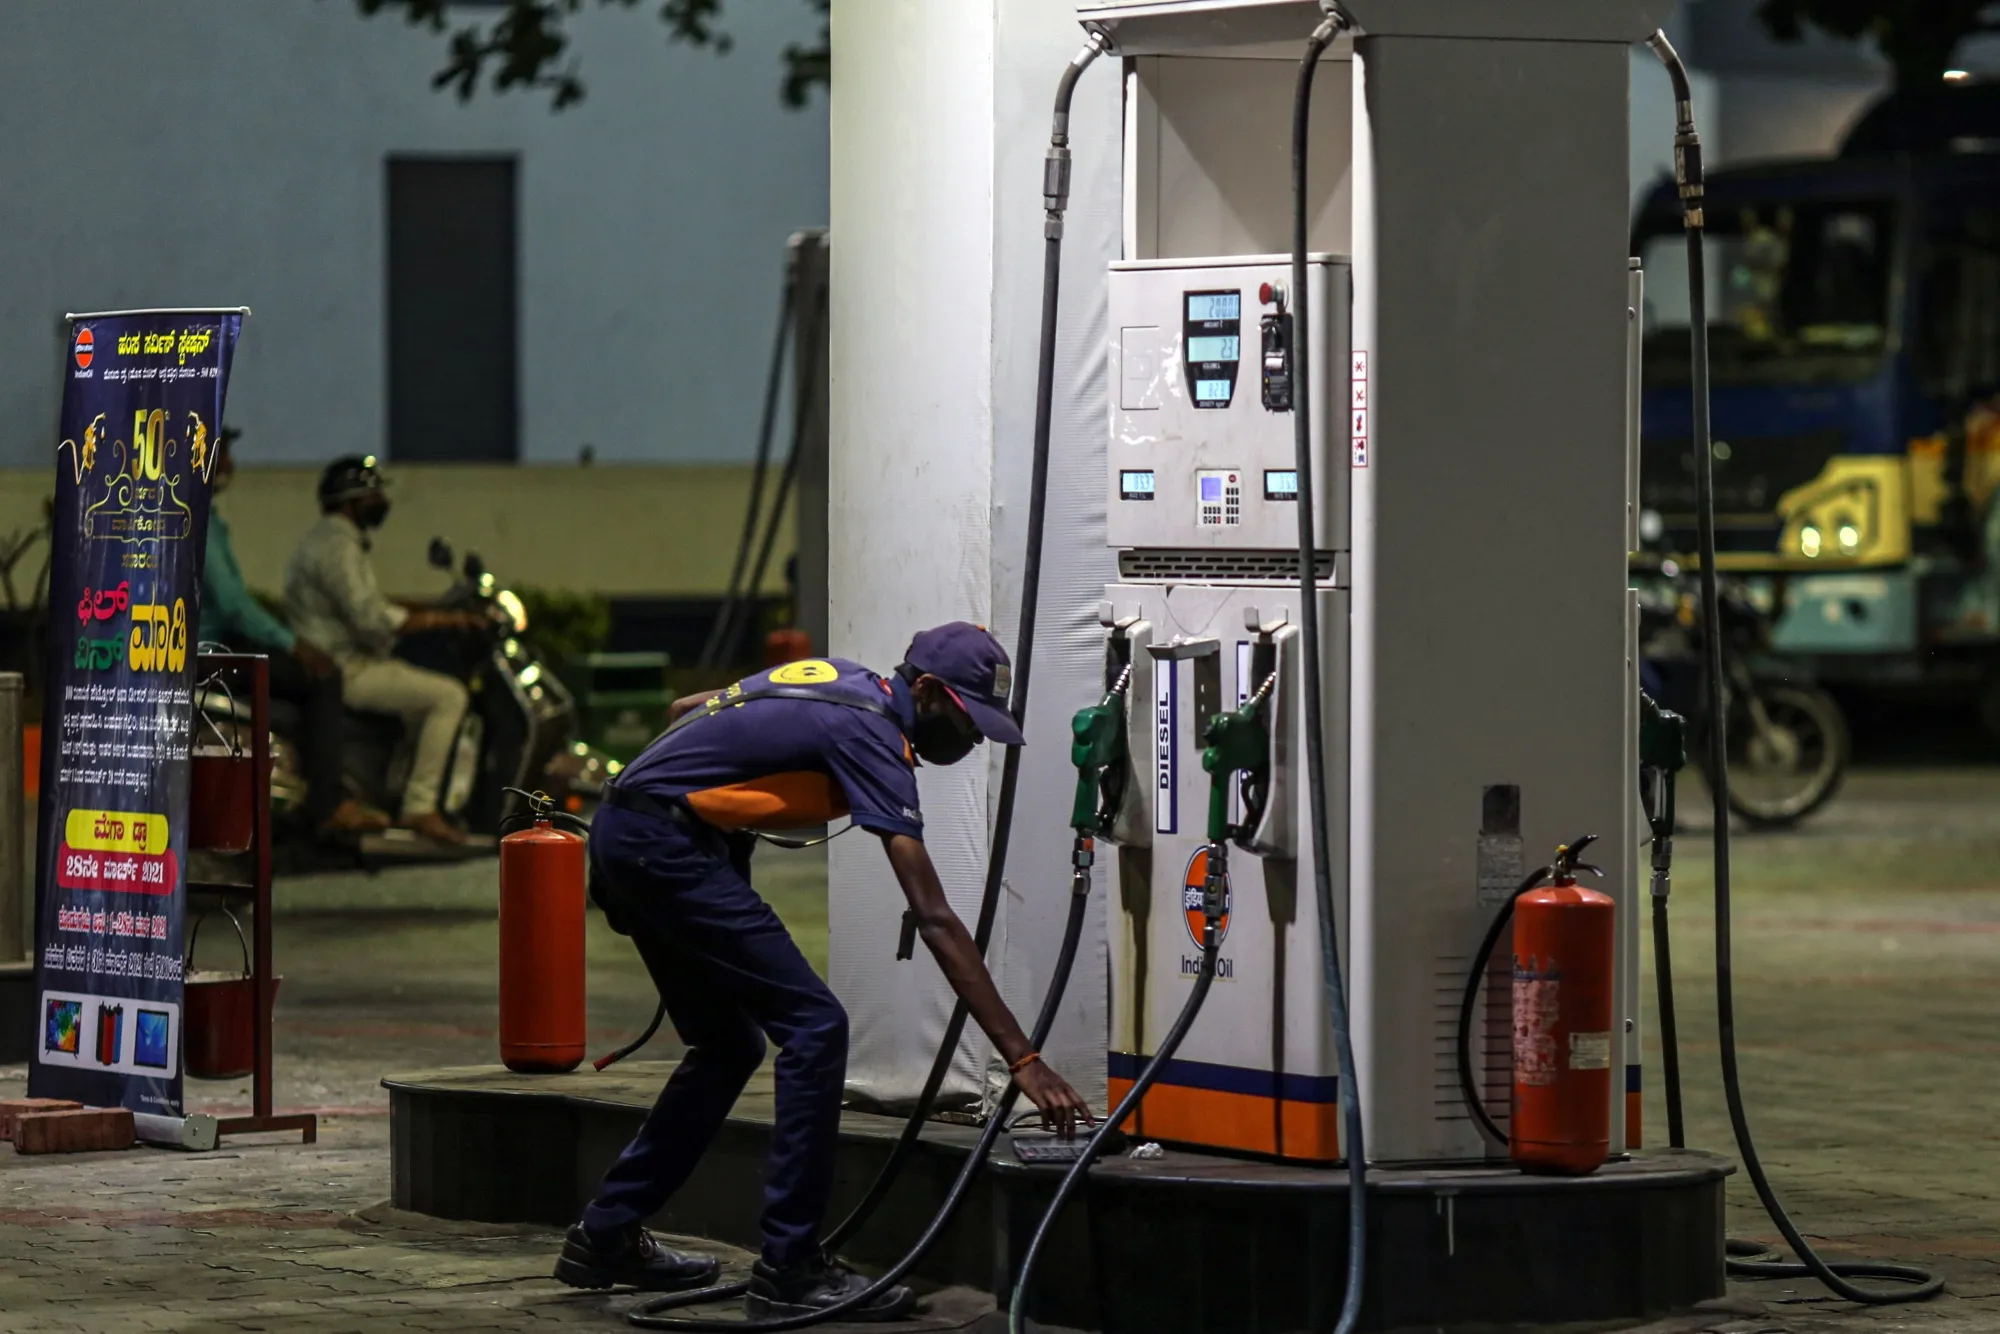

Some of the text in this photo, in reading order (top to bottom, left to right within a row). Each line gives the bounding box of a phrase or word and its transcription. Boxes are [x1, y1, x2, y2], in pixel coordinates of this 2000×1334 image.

[131, 408, 165, 481] 50
[129, 581, 186, 673] ಮಾಡಿ
[1159, 691, 1169, 789] DIESEL
[66, 854, 164, 884] 28ನೇ ಮಾರ್ಚ್ 2021
